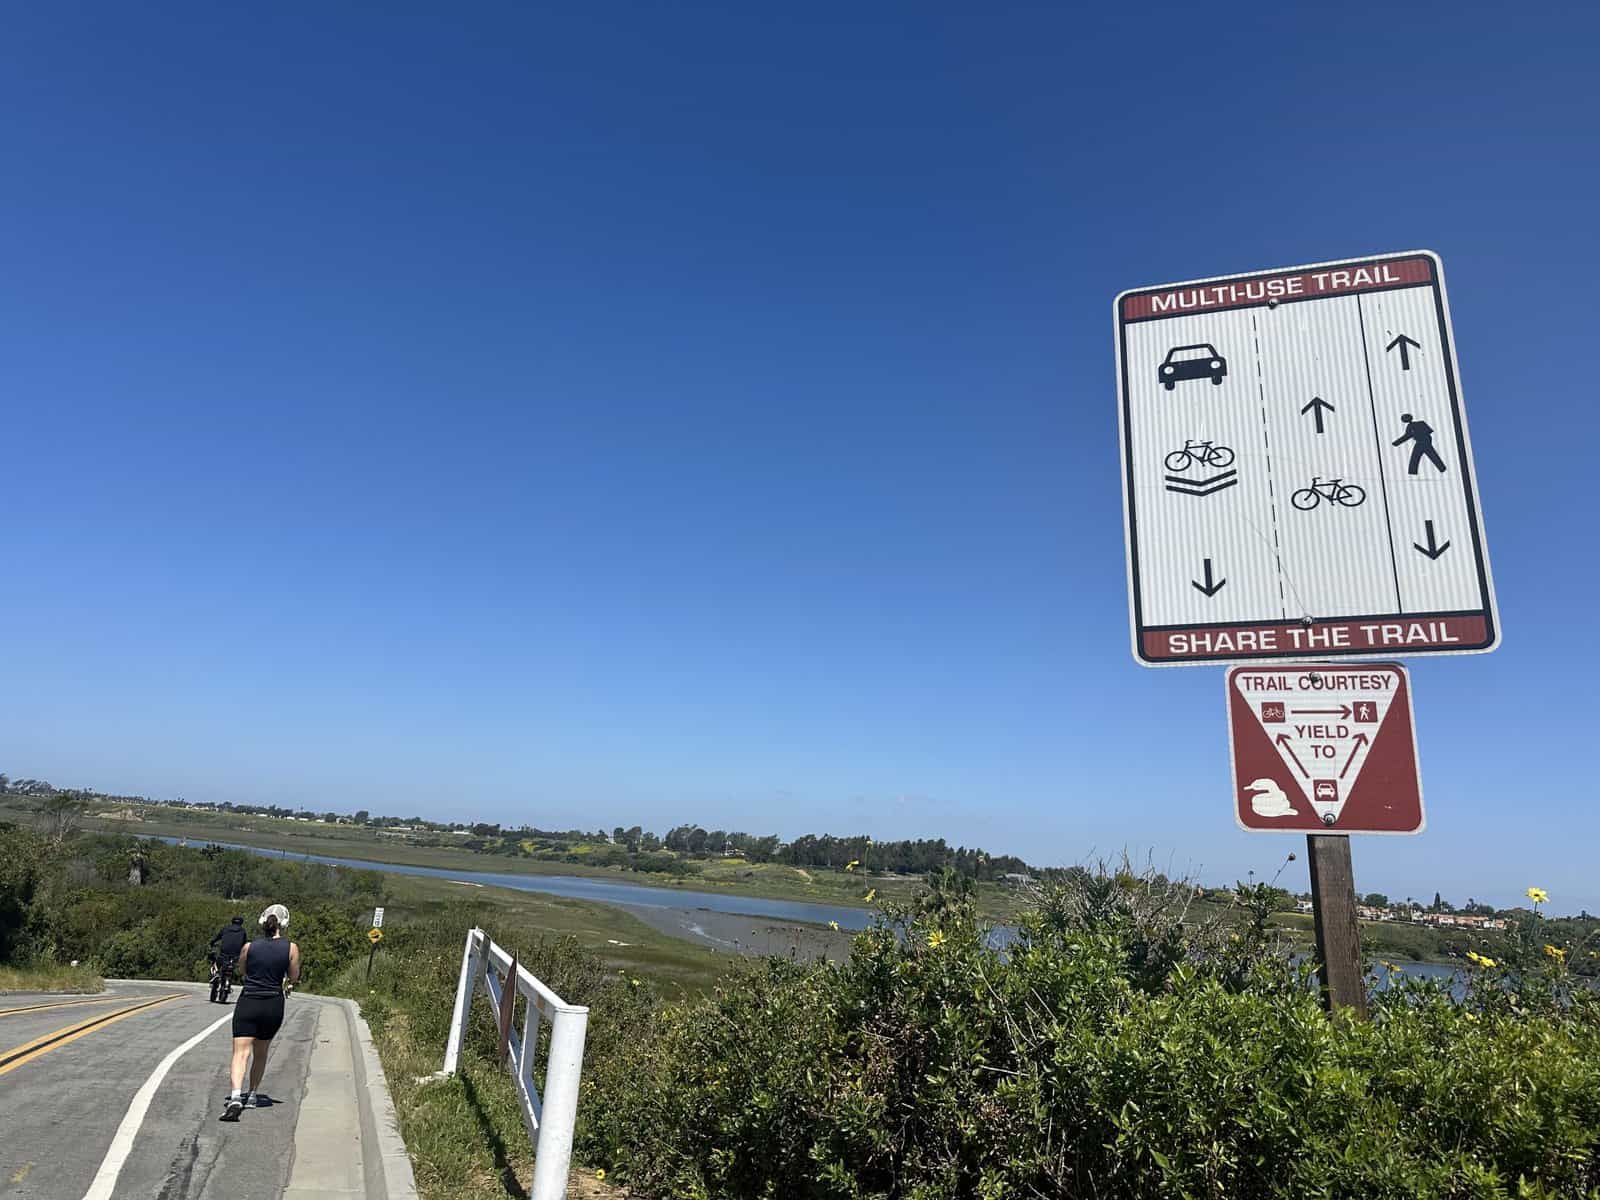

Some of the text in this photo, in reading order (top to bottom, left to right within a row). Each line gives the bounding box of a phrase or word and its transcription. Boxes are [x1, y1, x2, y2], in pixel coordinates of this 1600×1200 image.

[1151, 265, 1400, 312] MULTI-USE TRAIL
[1168, 621, 1459, 654] SHARE THE TRAIL
[1242, 675, 1392, 691] TRAIL COURTESY
[1294, 725, 1349, 739] YIELD
[1310, 744, 1337, 759] TO
